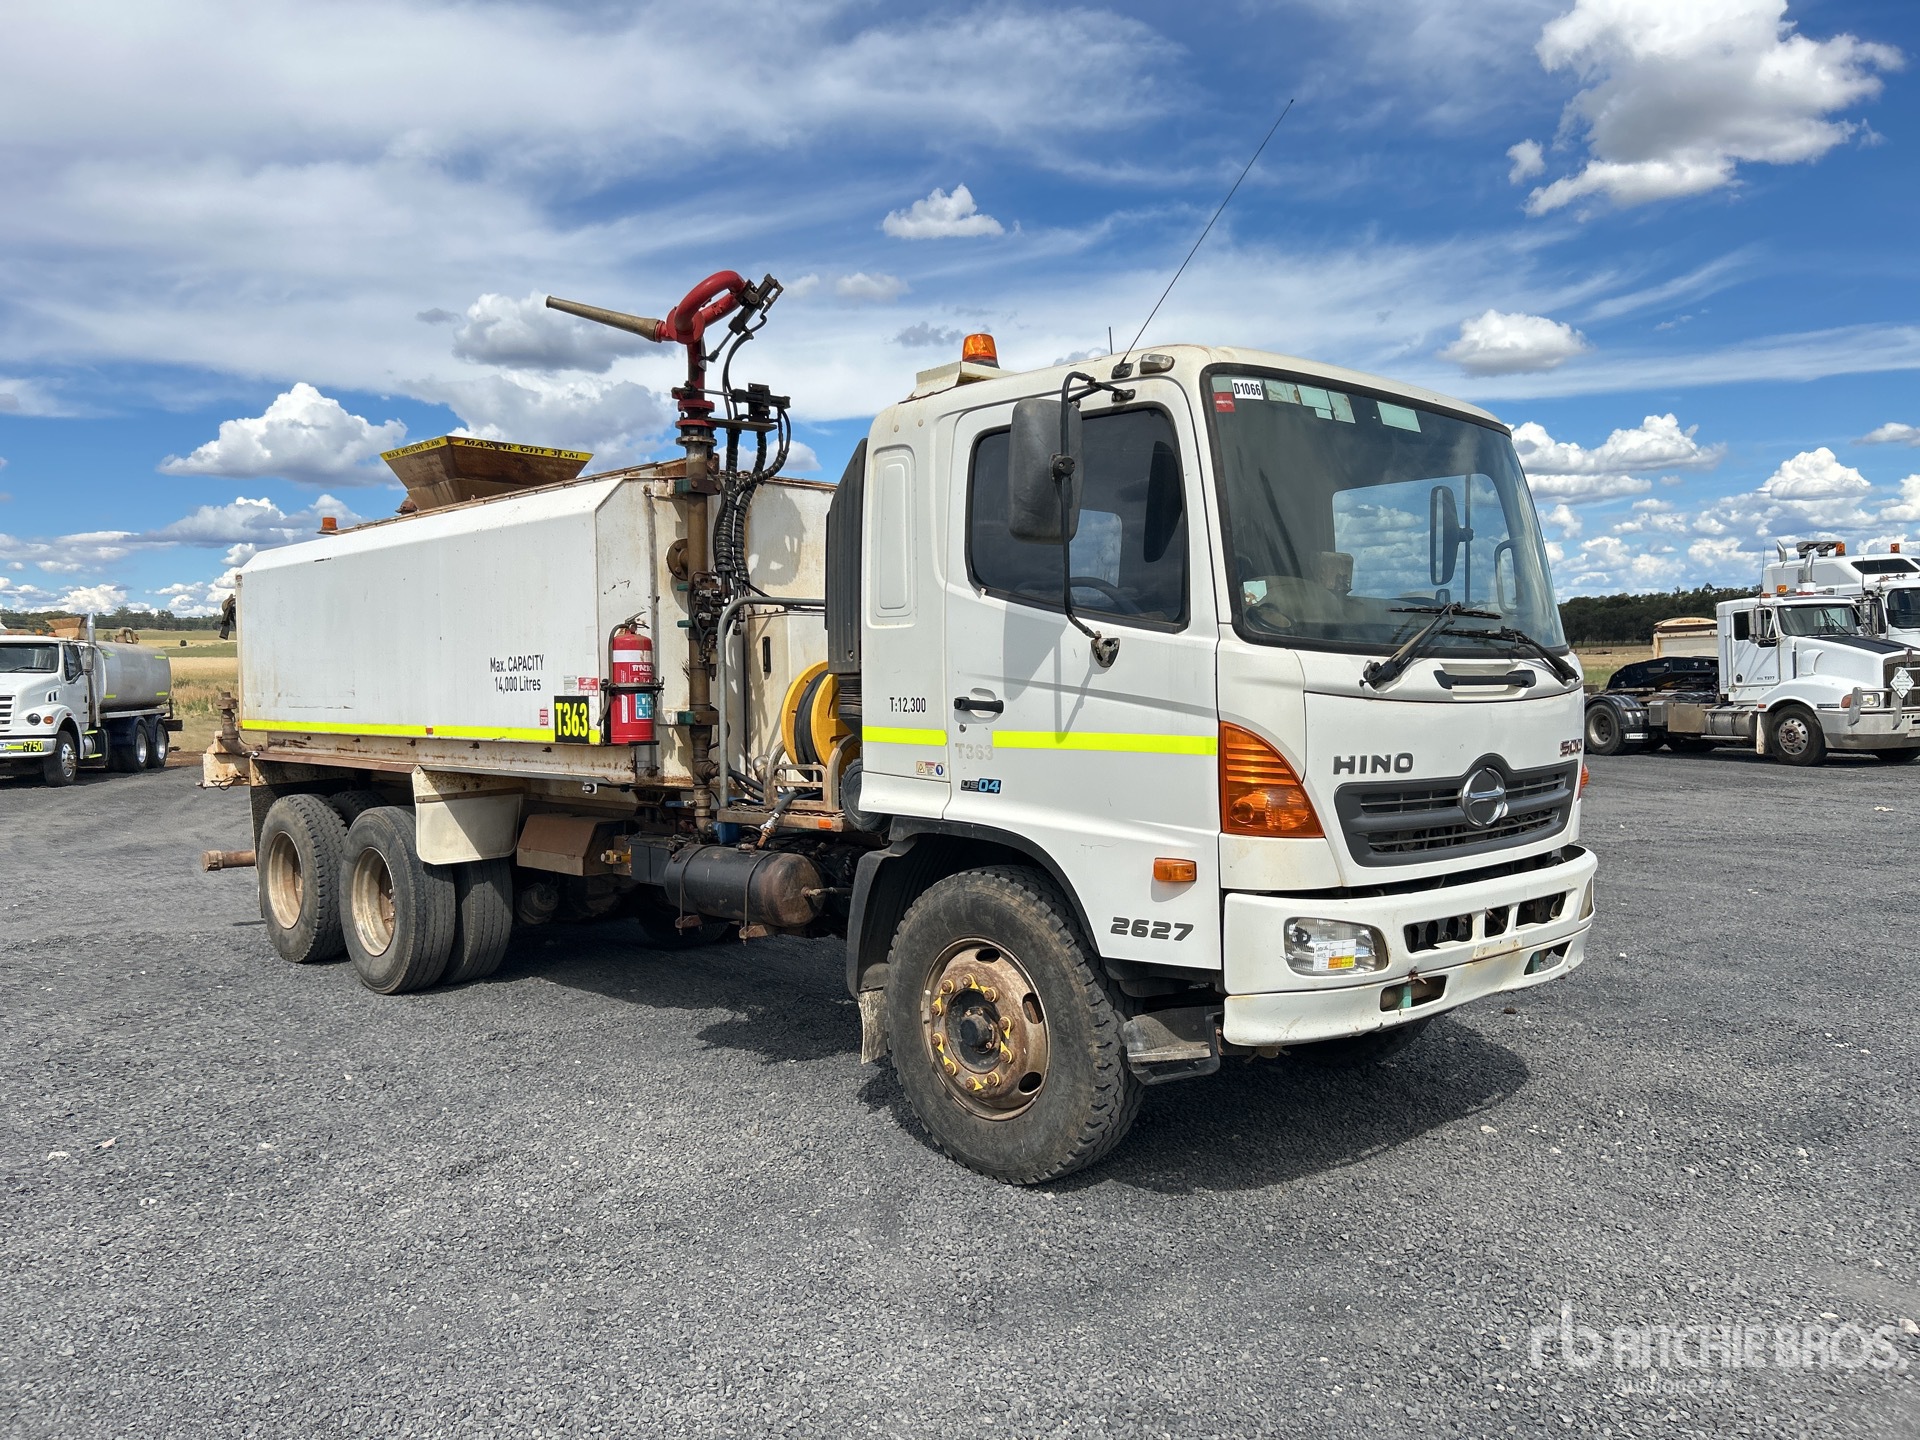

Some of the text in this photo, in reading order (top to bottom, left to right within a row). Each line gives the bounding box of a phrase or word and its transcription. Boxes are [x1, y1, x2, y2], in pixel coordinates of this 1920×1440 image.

[1233, 382, 1261, 396] D1066
[464, 439, 494, 449] MAX
[490, 654, 544, 672] Max. CAPACITY
[495, 675, 542, 694] 14,000 Litres
[890, 697, 926, 714] T:12,300
[555, 702, 588, 737] T363
[955, 743, 994, 761] T363
[1333, 752, 1414, 775] HINO
[1110, 916, 1194, 941] 2627
